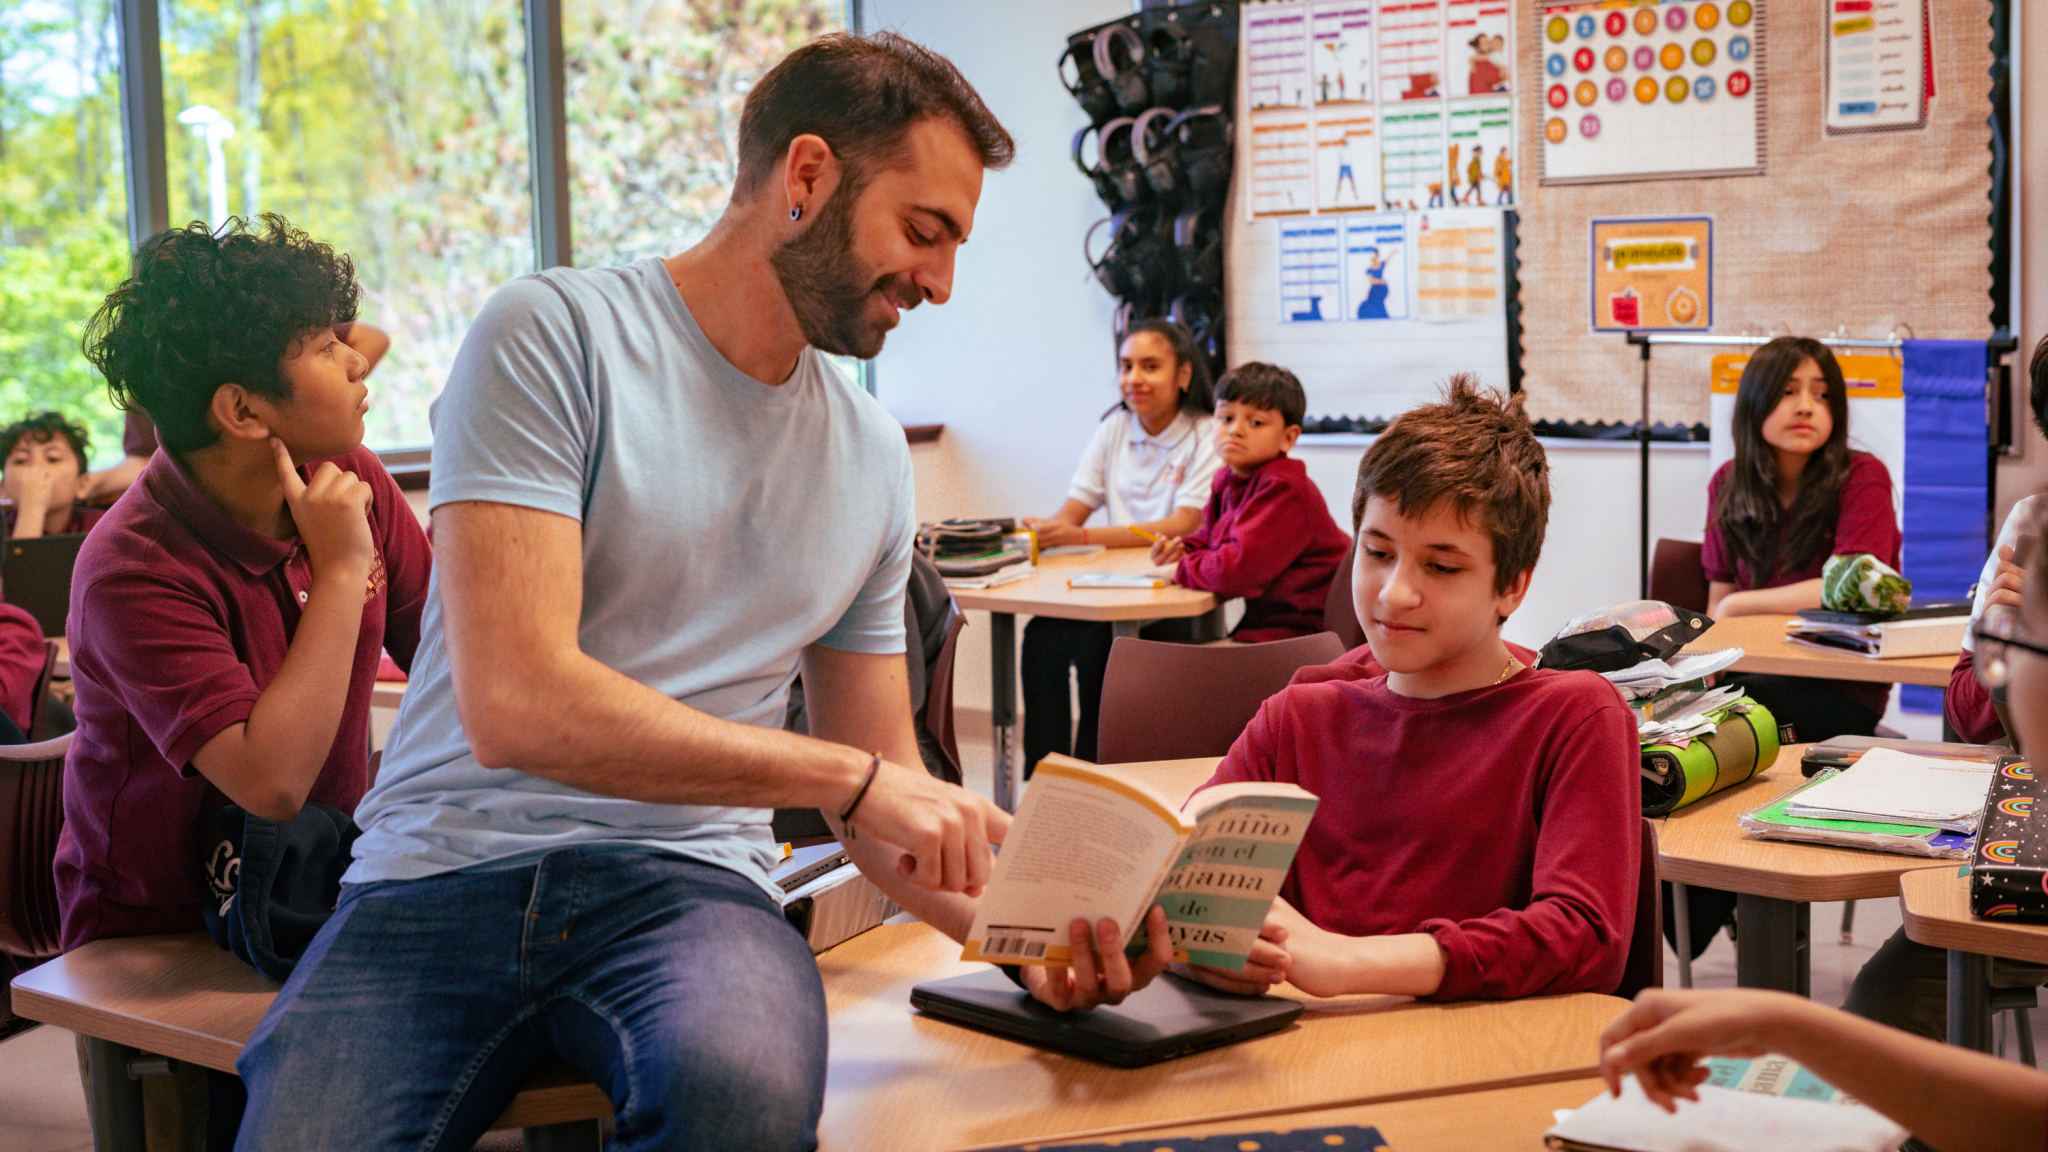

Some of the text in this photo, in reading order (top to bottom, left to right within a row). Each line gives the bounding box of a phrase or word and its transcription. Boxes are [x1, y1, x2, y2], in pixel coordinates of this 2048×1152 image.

[1217, 813, 1290, 836] niño
[1233, 843, 1258, 861] el
[1179, 900, 1208, 916] de
[1162, 925, 1227, 946] yas
